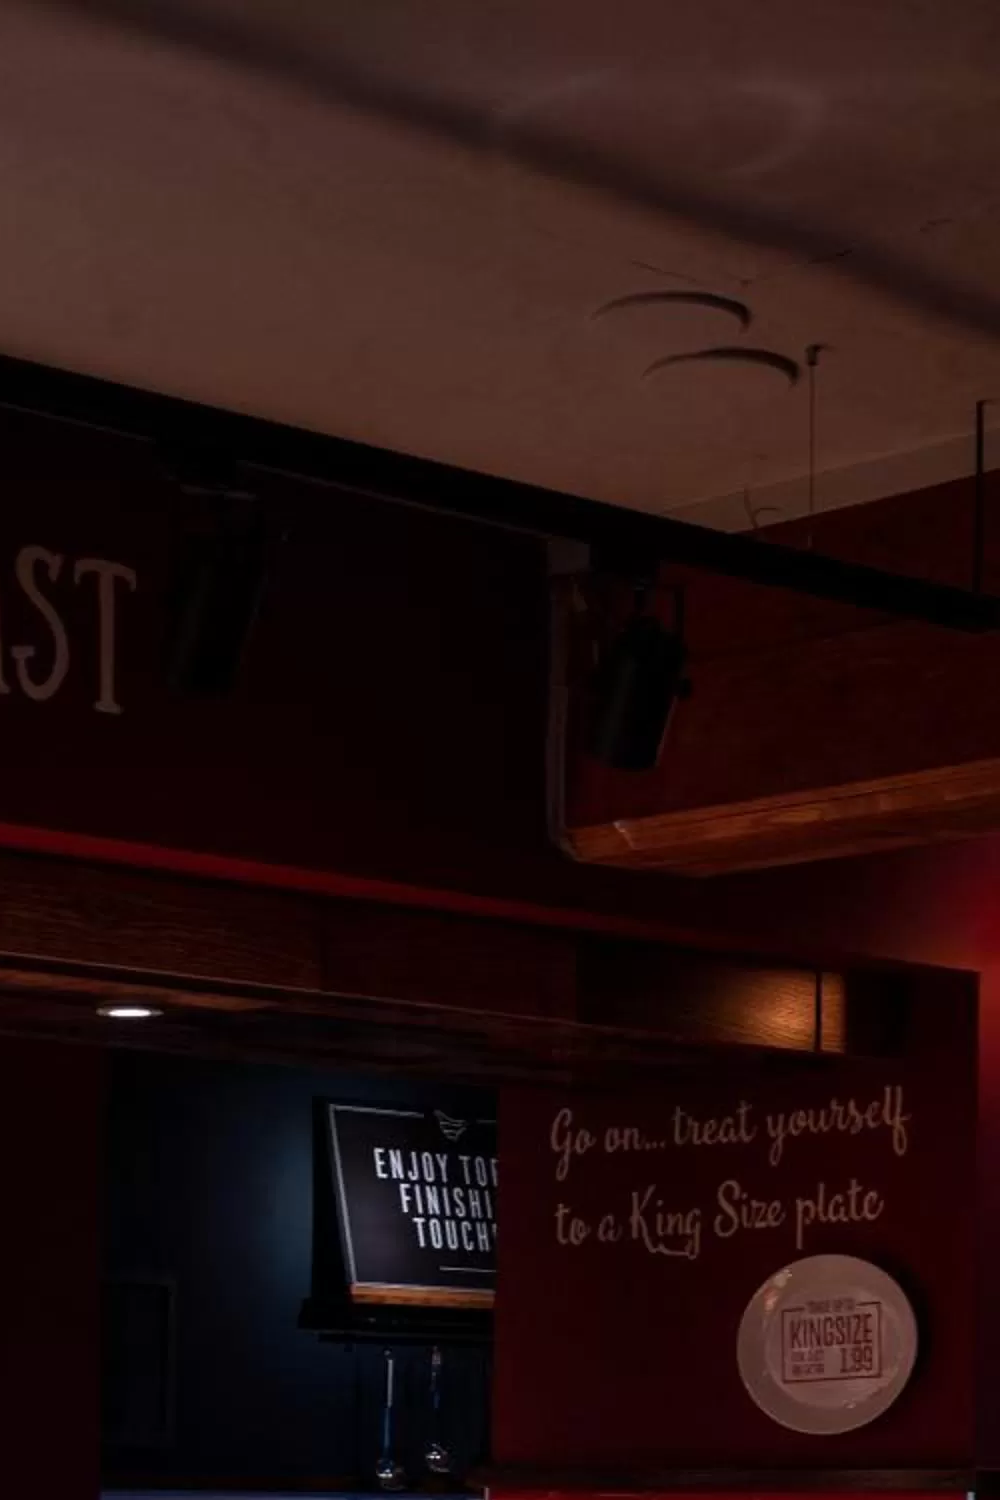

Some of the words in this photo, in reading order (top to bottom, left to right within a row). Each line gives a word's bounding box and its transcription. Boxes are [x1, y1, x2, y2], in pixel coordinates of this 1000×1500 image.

[550, 1107, 597, 1181] Go
[671, 1099, 758, 1146] treat
[766, 1084, 911, 1168] yourself
[373, 1147, 449, 1184] ENJOY
[399, 1183, 494, 1220] FINISHI
[554, 1202, 591, 1246] to
[597, 1212, 624, 1242] a
[629, 1183, 702, 1260] King
[712, 1178, 787, 1239] Size
[794, 1177, 885, 1250] plate
[790, 1313, 873, 1349] KINGSIZE
